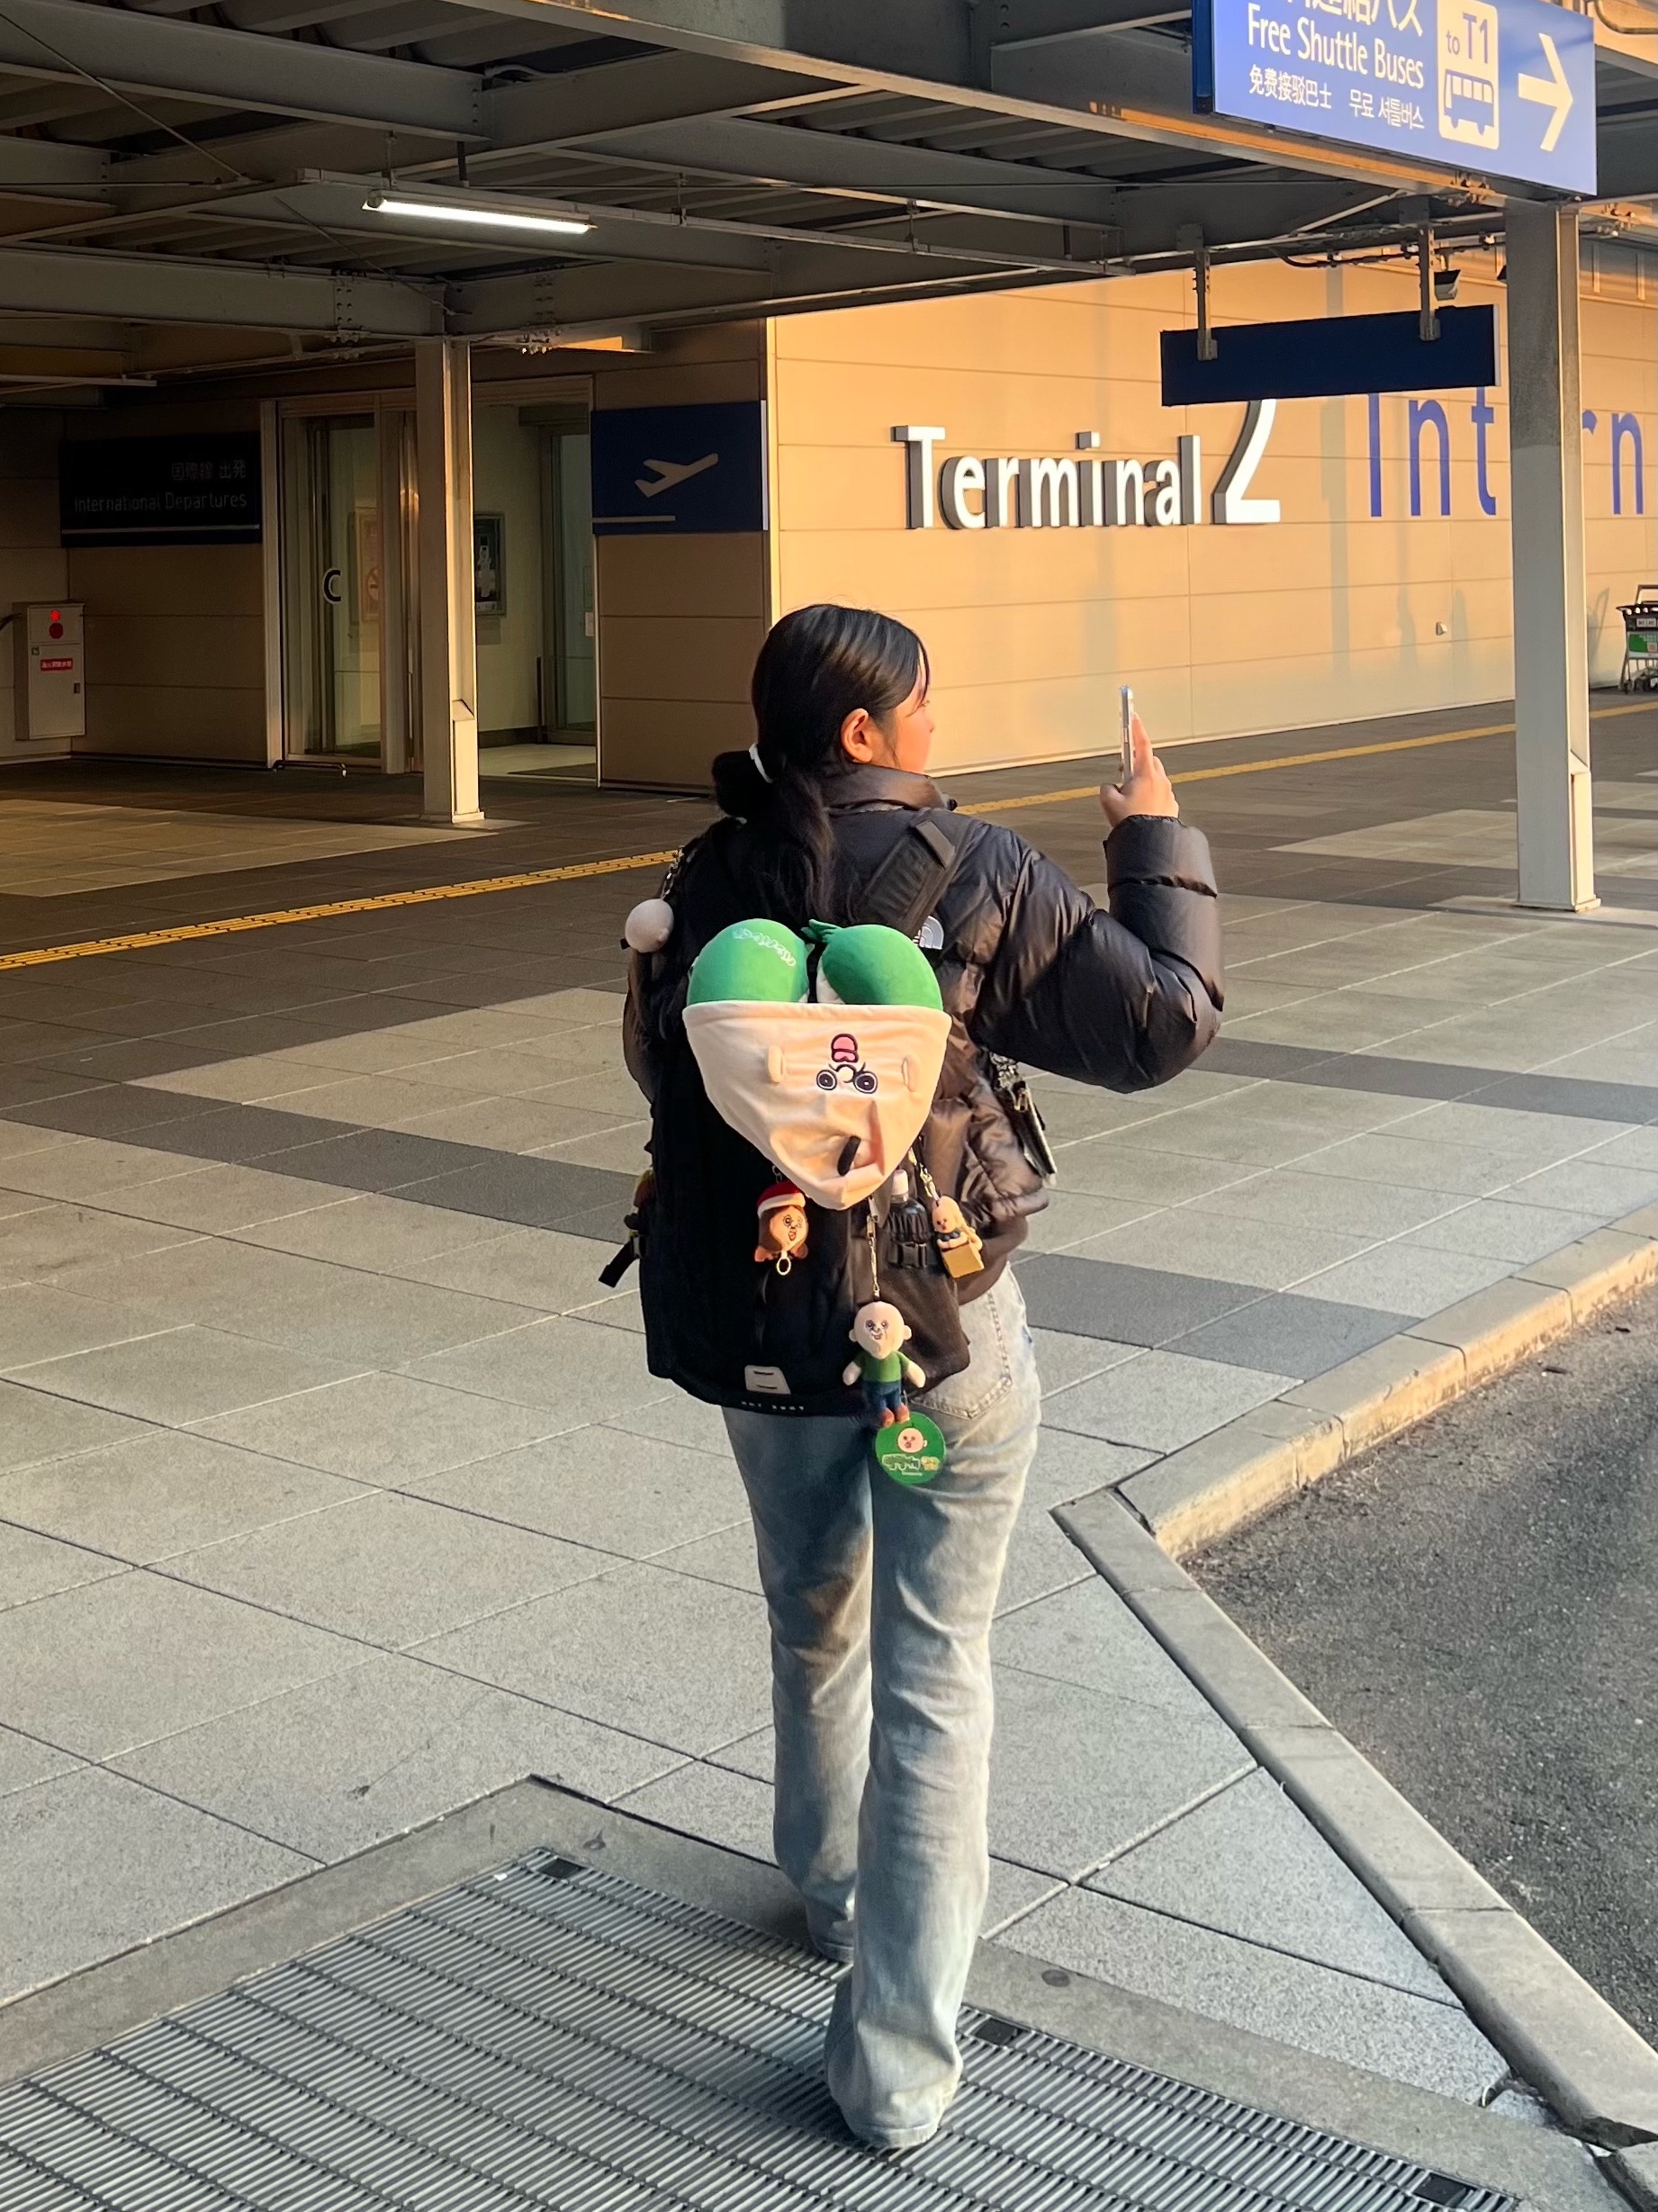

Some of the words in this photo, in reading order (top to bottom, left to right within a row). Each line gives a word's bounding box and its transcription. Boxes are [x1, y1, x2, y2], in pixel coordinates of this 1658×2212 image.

[1248, 3, 1291, 56] Free
[1297, 17, 1368, 76] Shuttle
[1374, 38, 1424, 89] Buses
[1446, 30, 1460, 55] to
[1463, 12, 1488, 64] T1
[1249, 64, 1332, 109] 免费接驳巴士
[1349, 88, 1374, 117] 무료
[1378, 96, 1425, 130] 셔틀버스
[891, 426, 1202, 529] Terminal
[1212, 399, 1281, 525] 2
[75, 493, 160, 512] International
[166, 492, 247, 511] Departures
